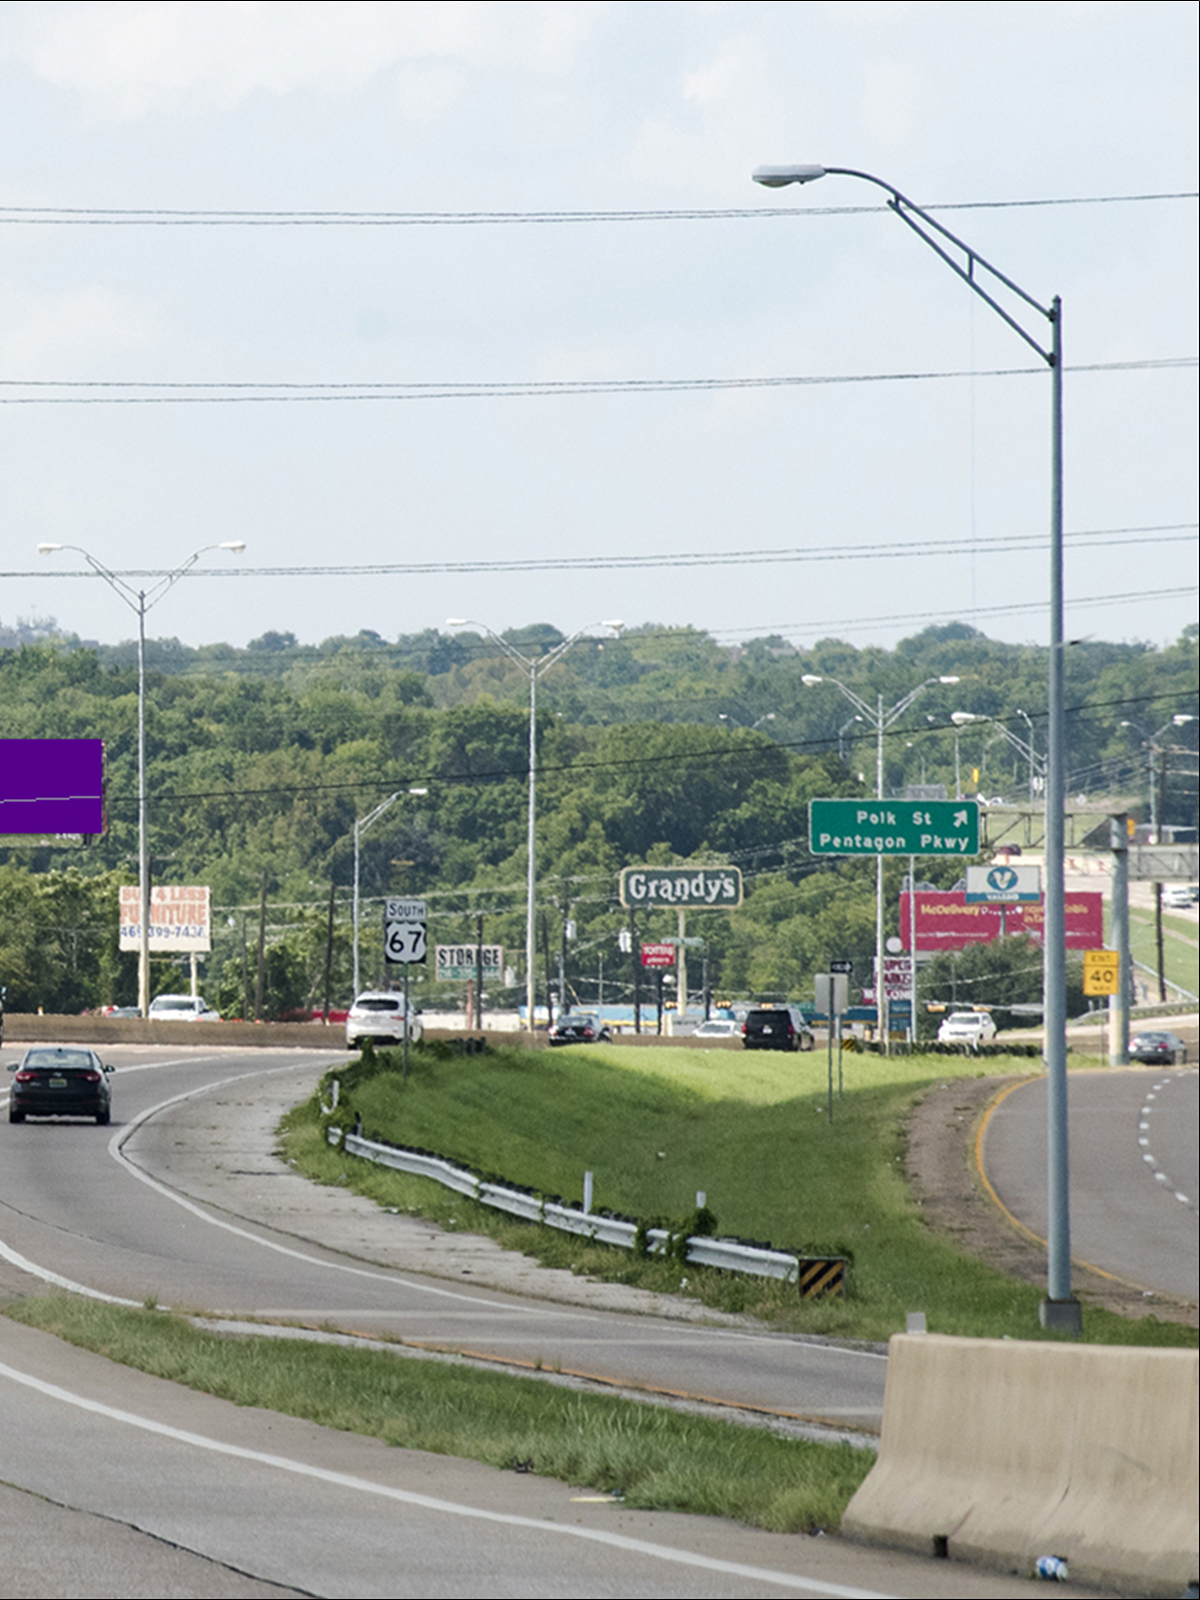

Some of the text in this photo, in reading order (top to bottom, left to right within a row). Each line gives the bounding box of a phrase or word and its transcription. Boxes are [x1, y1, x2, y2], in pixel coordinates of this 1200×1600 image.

[856, 810, 932, 825] Polk St
[819, 833, 969, 852] Pentagon Pkwy
[156, 887, 166, 901] 4
[170, 887, 207, 901] LESS
[628, 872, 736, 903] Grandy's
[120, 903, 207, 925] FUNITURE
[389, 902, 424, 917] SOUTH
[921, 903, 980, 917] McDelivery
[389, 931, 422, 953] 67
[1090, 969, 1114, 984] 40
